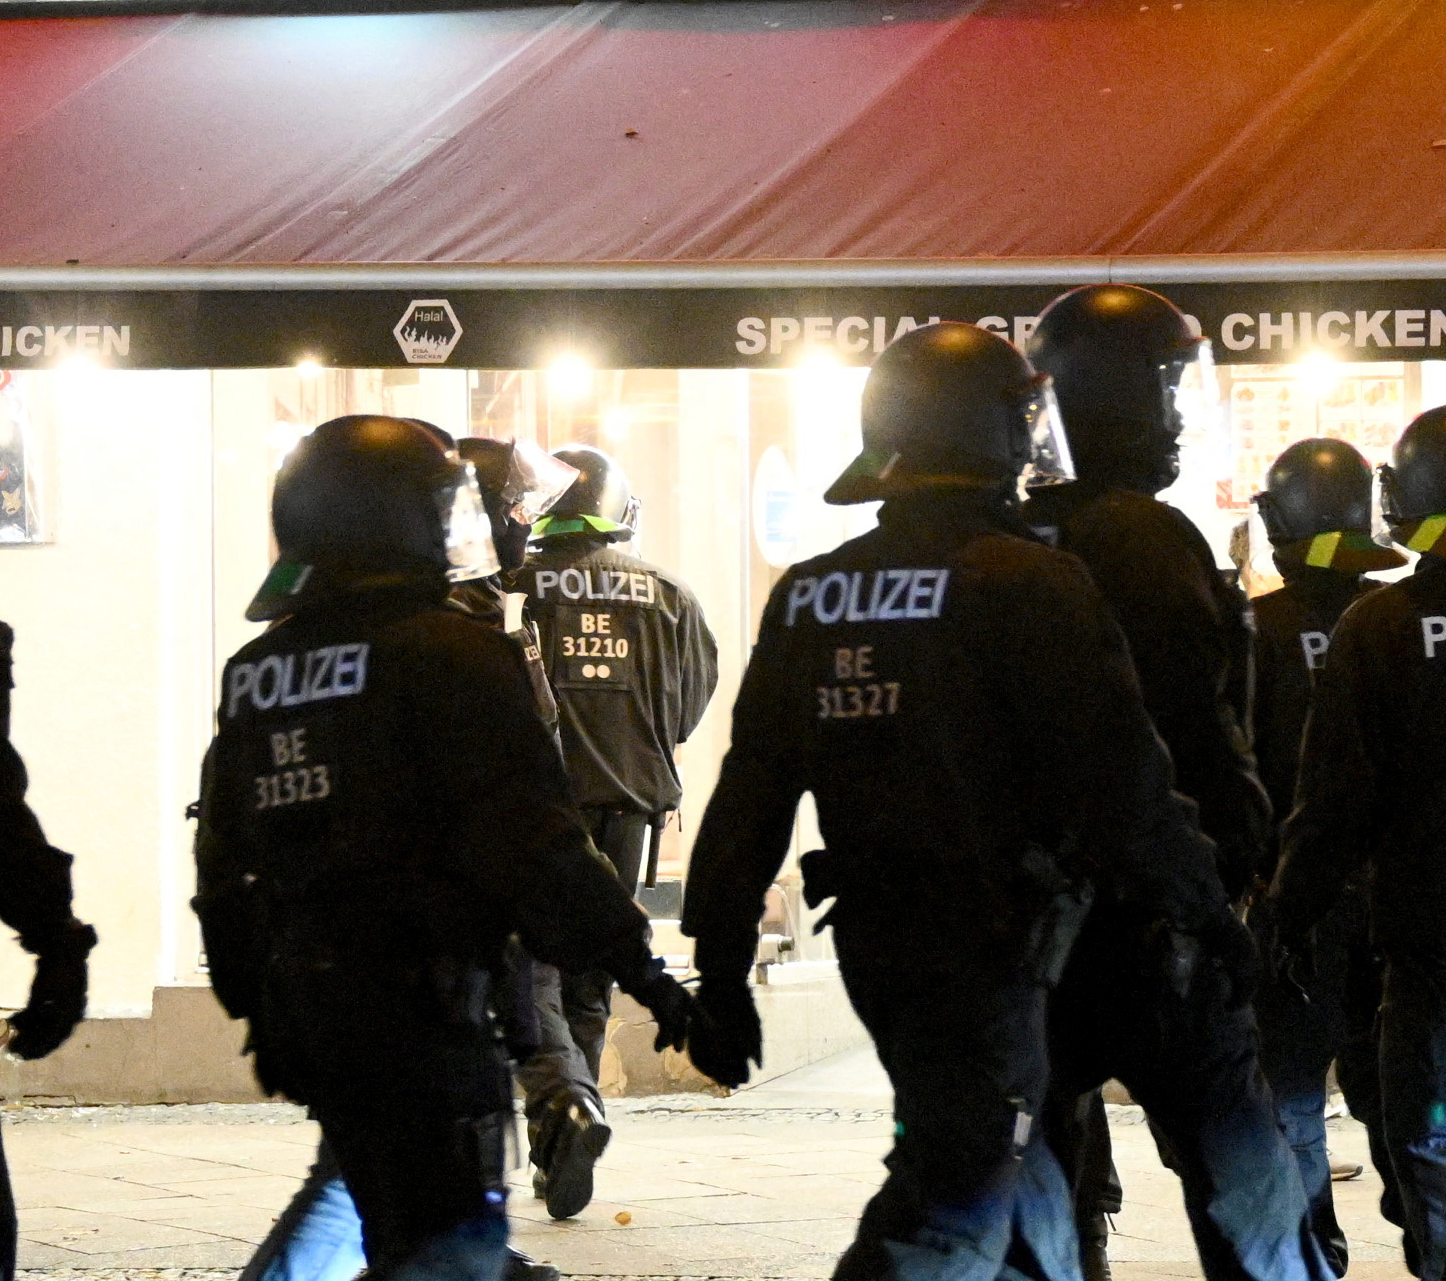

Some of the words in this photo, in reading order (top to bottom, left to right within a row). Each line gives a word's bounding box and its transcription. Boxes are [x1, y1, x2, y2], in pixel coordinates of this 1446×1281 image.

[415, 310, 444, 322] Halal
[535, 568, 655, 604] POLIZEI
[785, 568, 950, 627] POLIZEI
[581, 613, 611, 634] BE
[562, 636, 629, 659] 31210
[834, 645, 876, 679] BE
[227, 643, 371, 718] POLIZEI
[816, 682, 900, 719] 31327
[271, 728, 307, 766] BE
